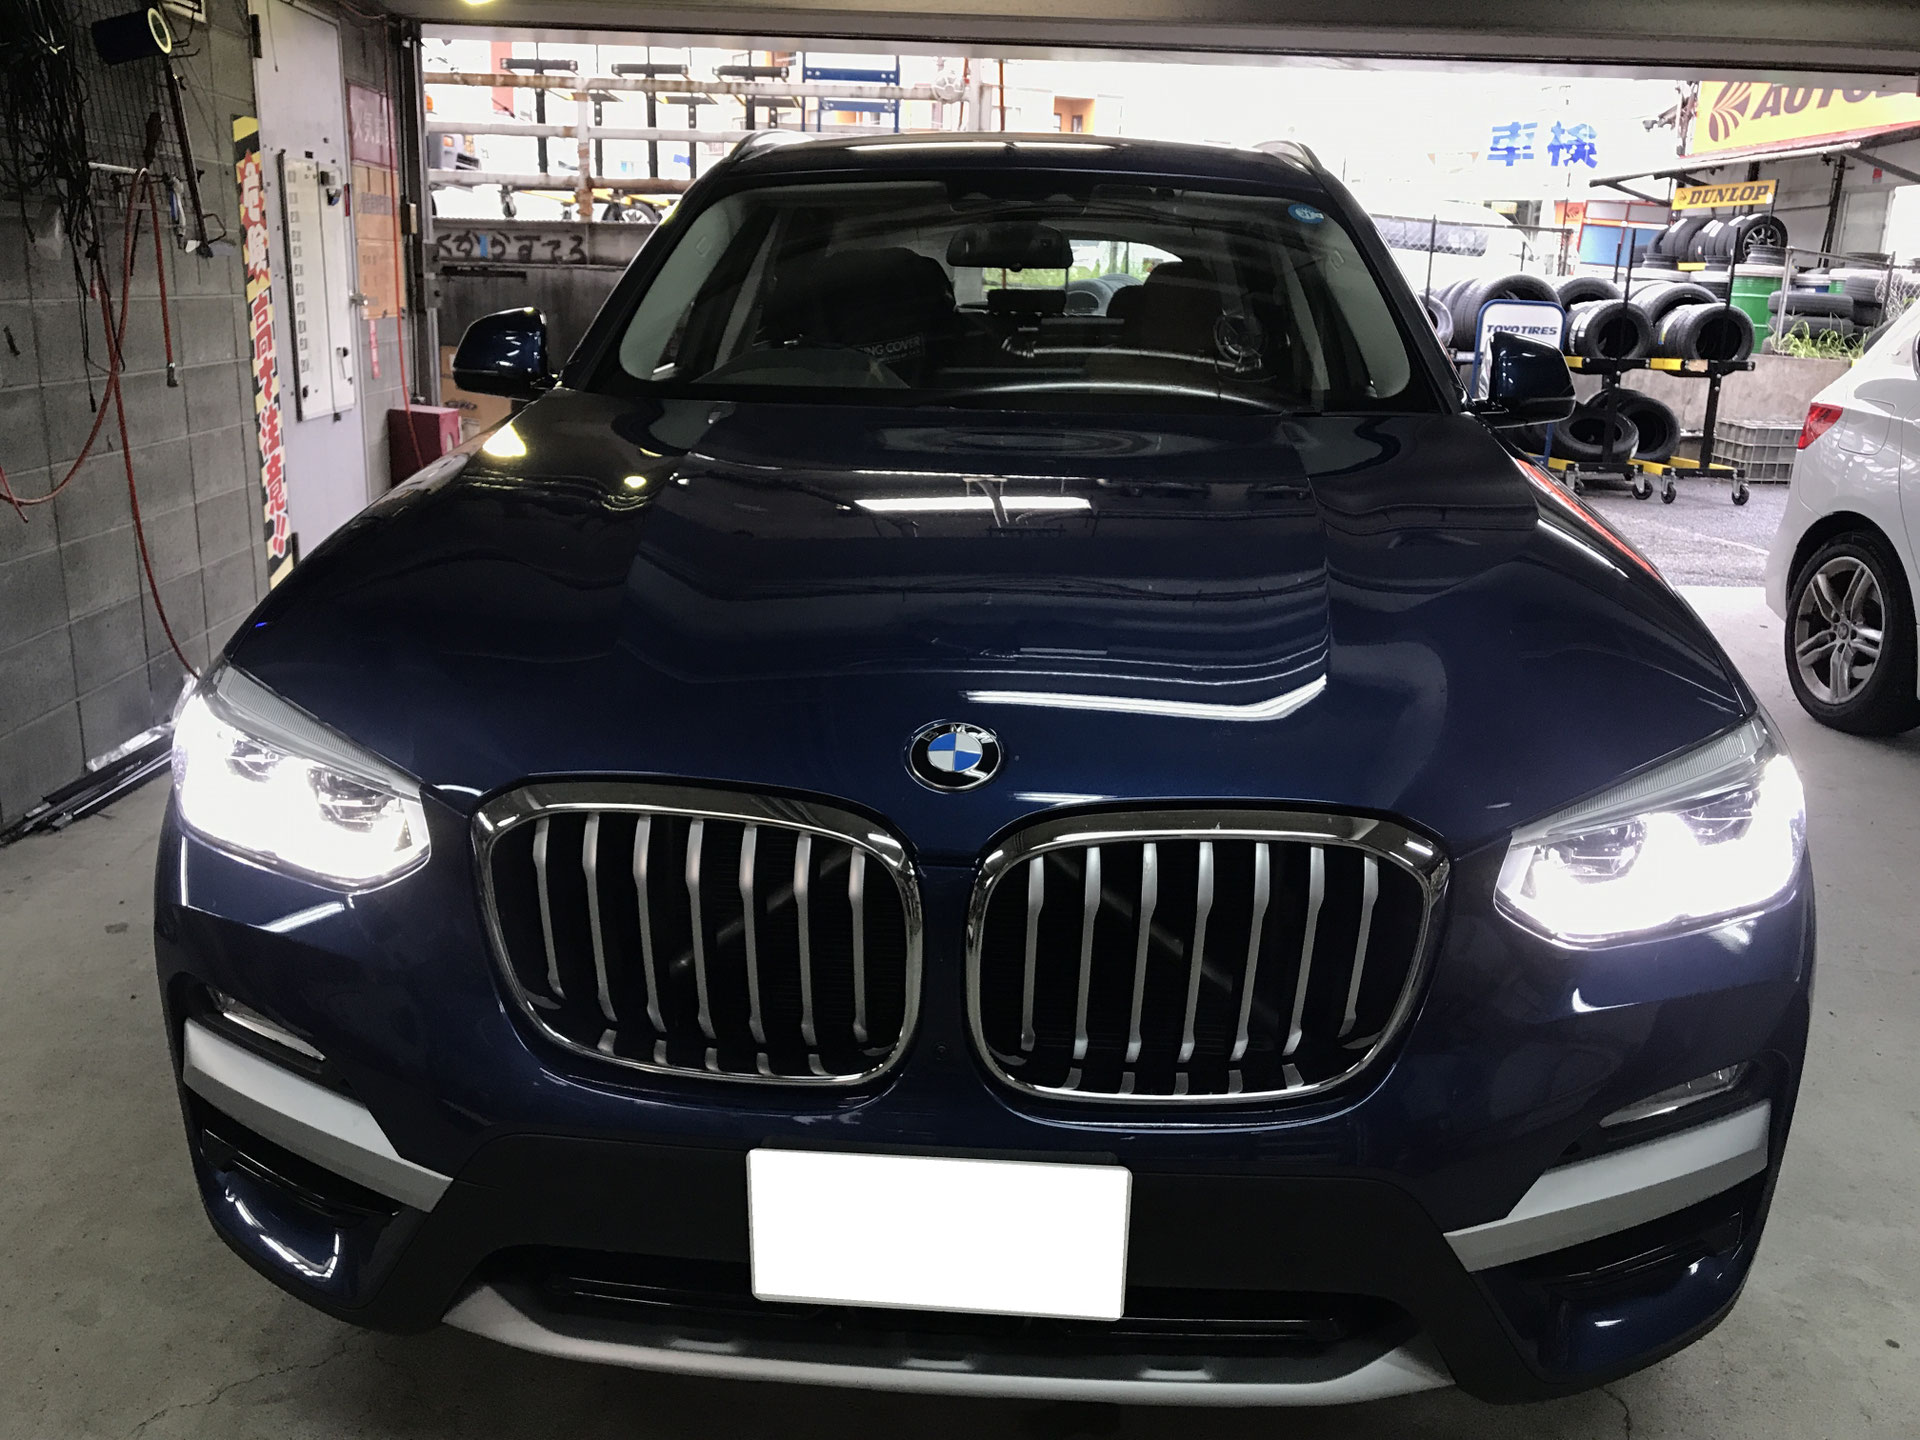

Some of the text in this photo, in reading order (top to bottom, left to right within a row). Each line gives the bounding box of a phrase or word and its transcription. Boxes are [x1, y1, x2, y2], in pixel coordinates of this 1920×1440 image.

[1750, 83, 1900, 120] AUT
[1486, 120, 1598, 168] 車検
[1687, 185, 1769, 205] DUNLOP
[243, 161, 267, 274] 危険
[1487, 325, 1558, 335] TOYO TIRES
